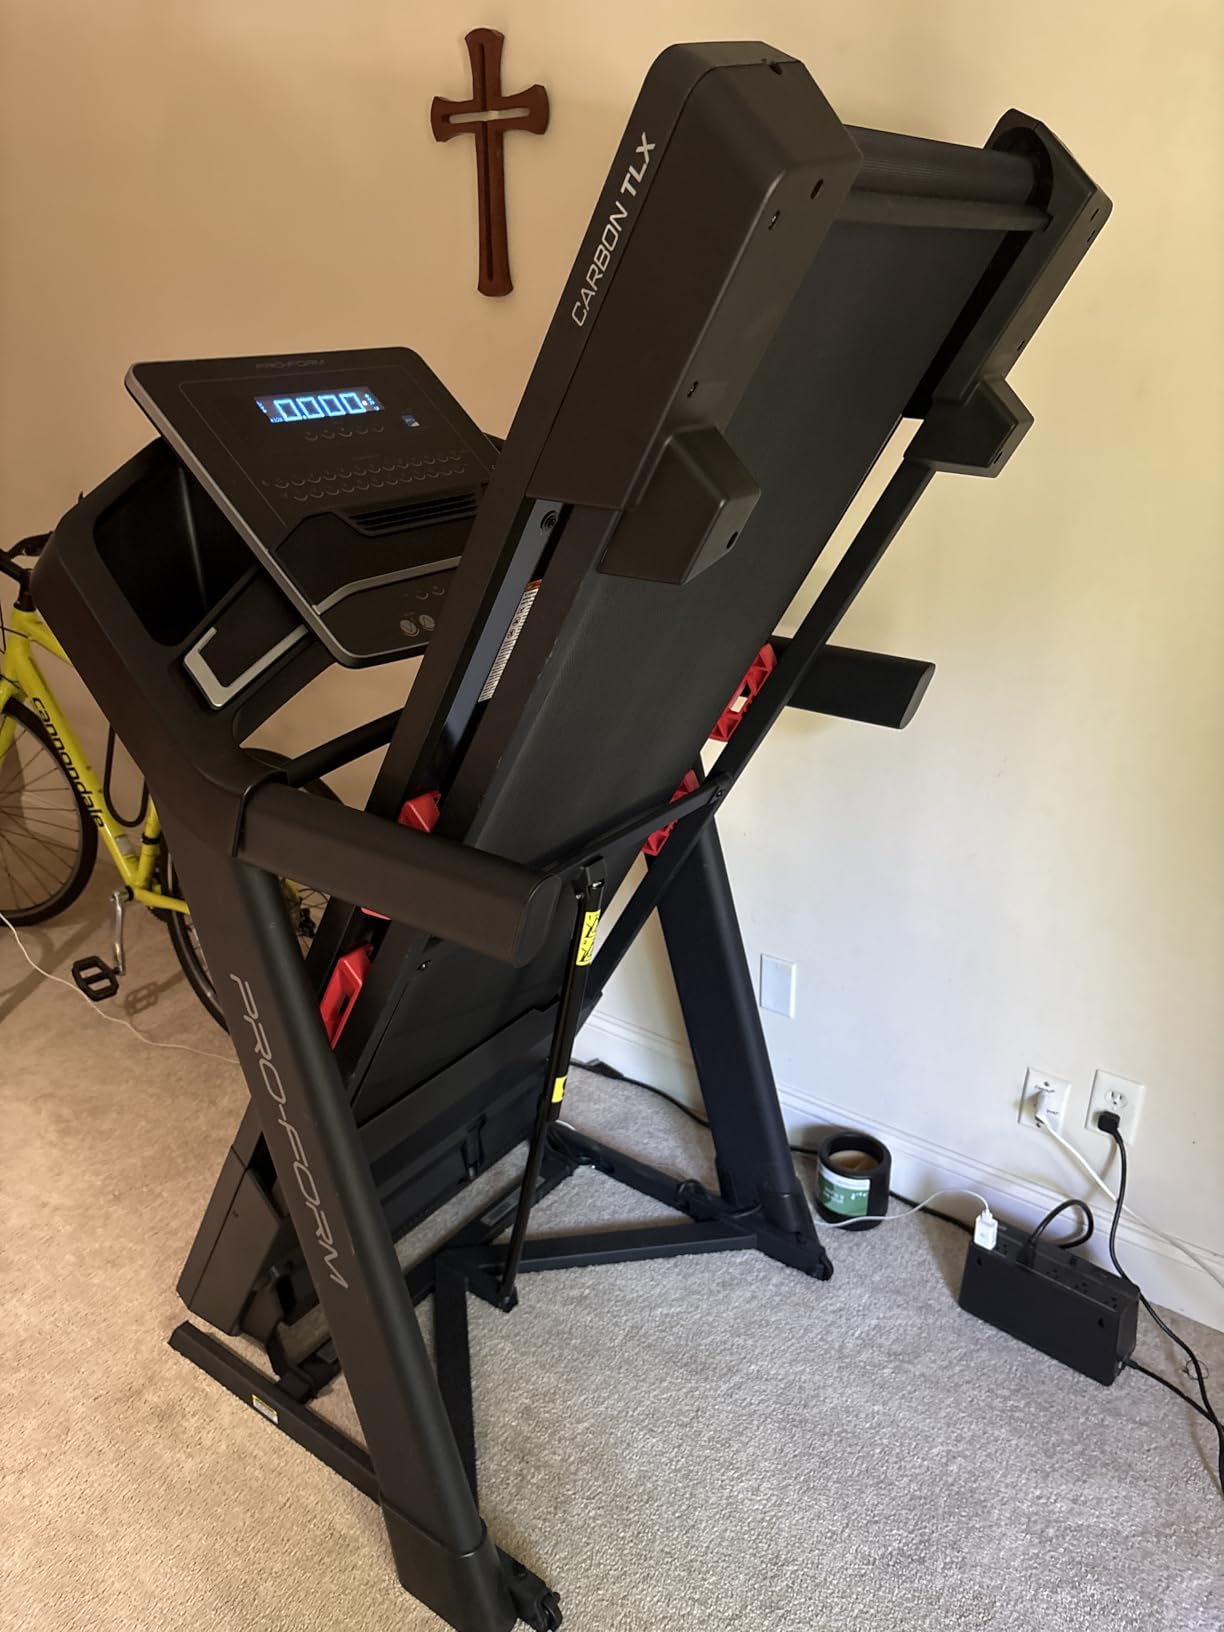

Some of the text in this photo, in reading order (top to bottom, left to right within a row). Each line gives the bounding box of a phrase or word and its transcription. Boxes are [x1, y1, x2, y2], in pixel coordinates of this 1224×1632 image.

[571, 132, 656, 327] CARBON TLX
[33, 697, 104, 827] cannondale
[230, 973, 348, 1288] PRO-FORM
